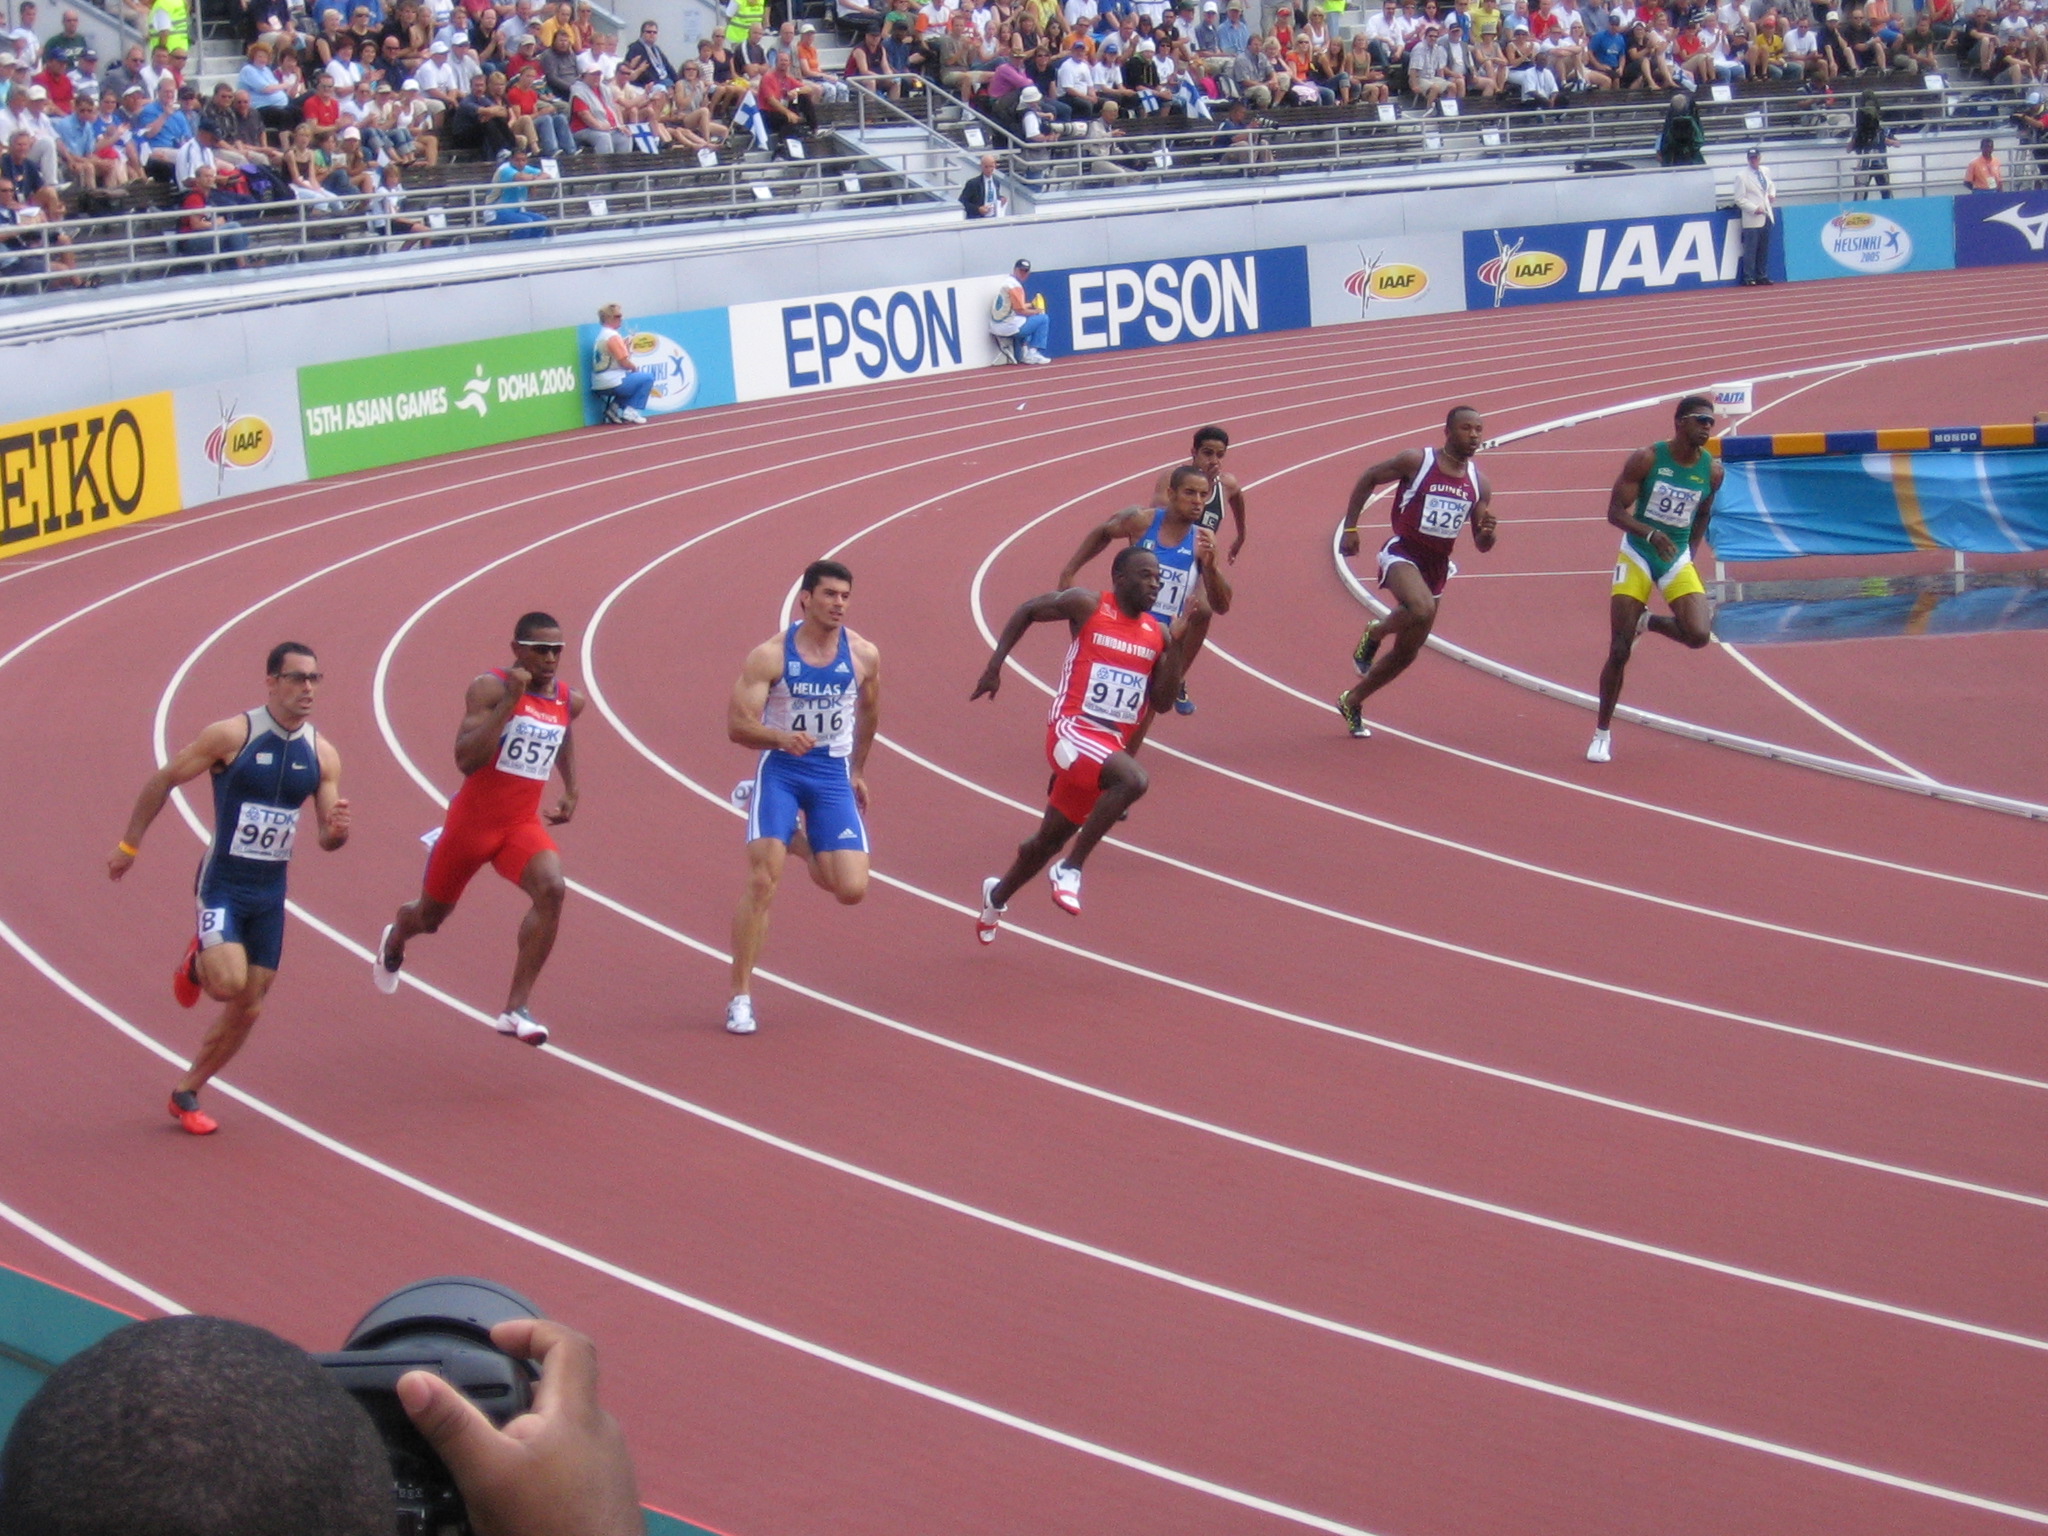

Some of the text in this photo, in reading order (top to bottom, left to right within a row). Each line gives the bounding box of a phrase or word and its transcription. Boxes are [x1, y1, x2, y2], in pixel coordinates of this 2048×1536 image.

[1833, 235, 1882, 253] HELSINKI
[1860, 251, 1881, 263] 2005
[1515, 263, 1554, 278] IAAF
[1379, 274, 1415, 290] IAAF
[1068, 256, 1259, 351] EPSON
[782, 287, 963, 388] EPSON
[498, 365, 576, 403] DOHA 2006
[306, 387, 448, 436] 15TH ASIAN GAMES
[232, 429, 263, 453] IAAF
[1934, 432, 1977, 443] MONDO
[1667, 487, 1697, 501] TDK
[1438, 499, 1467, 513] TDK
[1659, 498, 1686, 517] 94
[1426, 510, 1463, 529] 426
[1109, 669, 1143, 689] TDK
[793, 682, 841, 697] HELLAS
[1091, 682, 1140, 711] 914
[807, 697, 843, 710] TDK
[791, 711, 843, 733] 416
[527, 724, 560, 742] TDK
[507, 737, 556, 766] 657
[240, 824, 290, 849] 961
